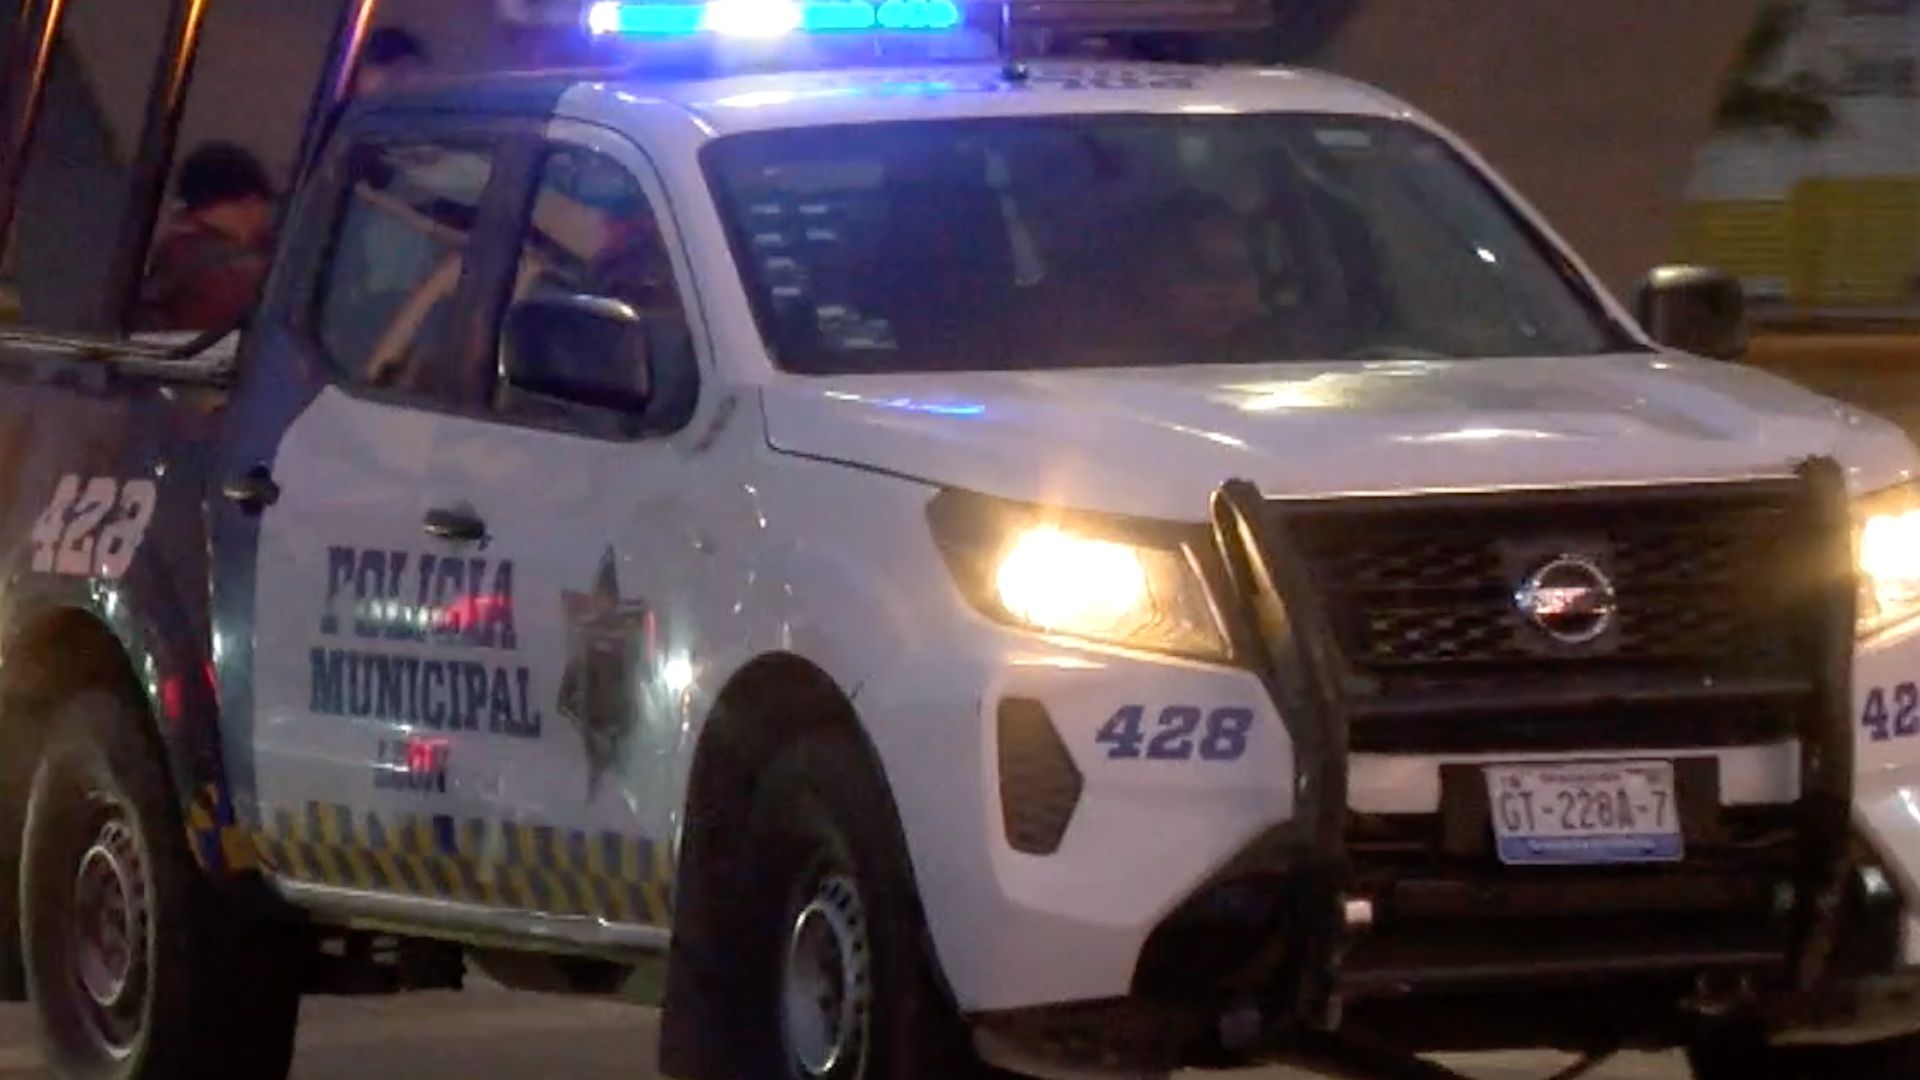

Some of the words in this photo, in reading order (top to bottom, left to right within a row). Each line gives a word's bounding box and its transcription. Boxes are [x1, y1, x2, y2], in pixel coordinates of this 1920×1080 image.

[31, 475, 157, 578] 428
[309, 647, 541, 738] MUNICIPAL
[1862, 682, 1920, 741] 42
[1095, 704, 1254, 760] 428
